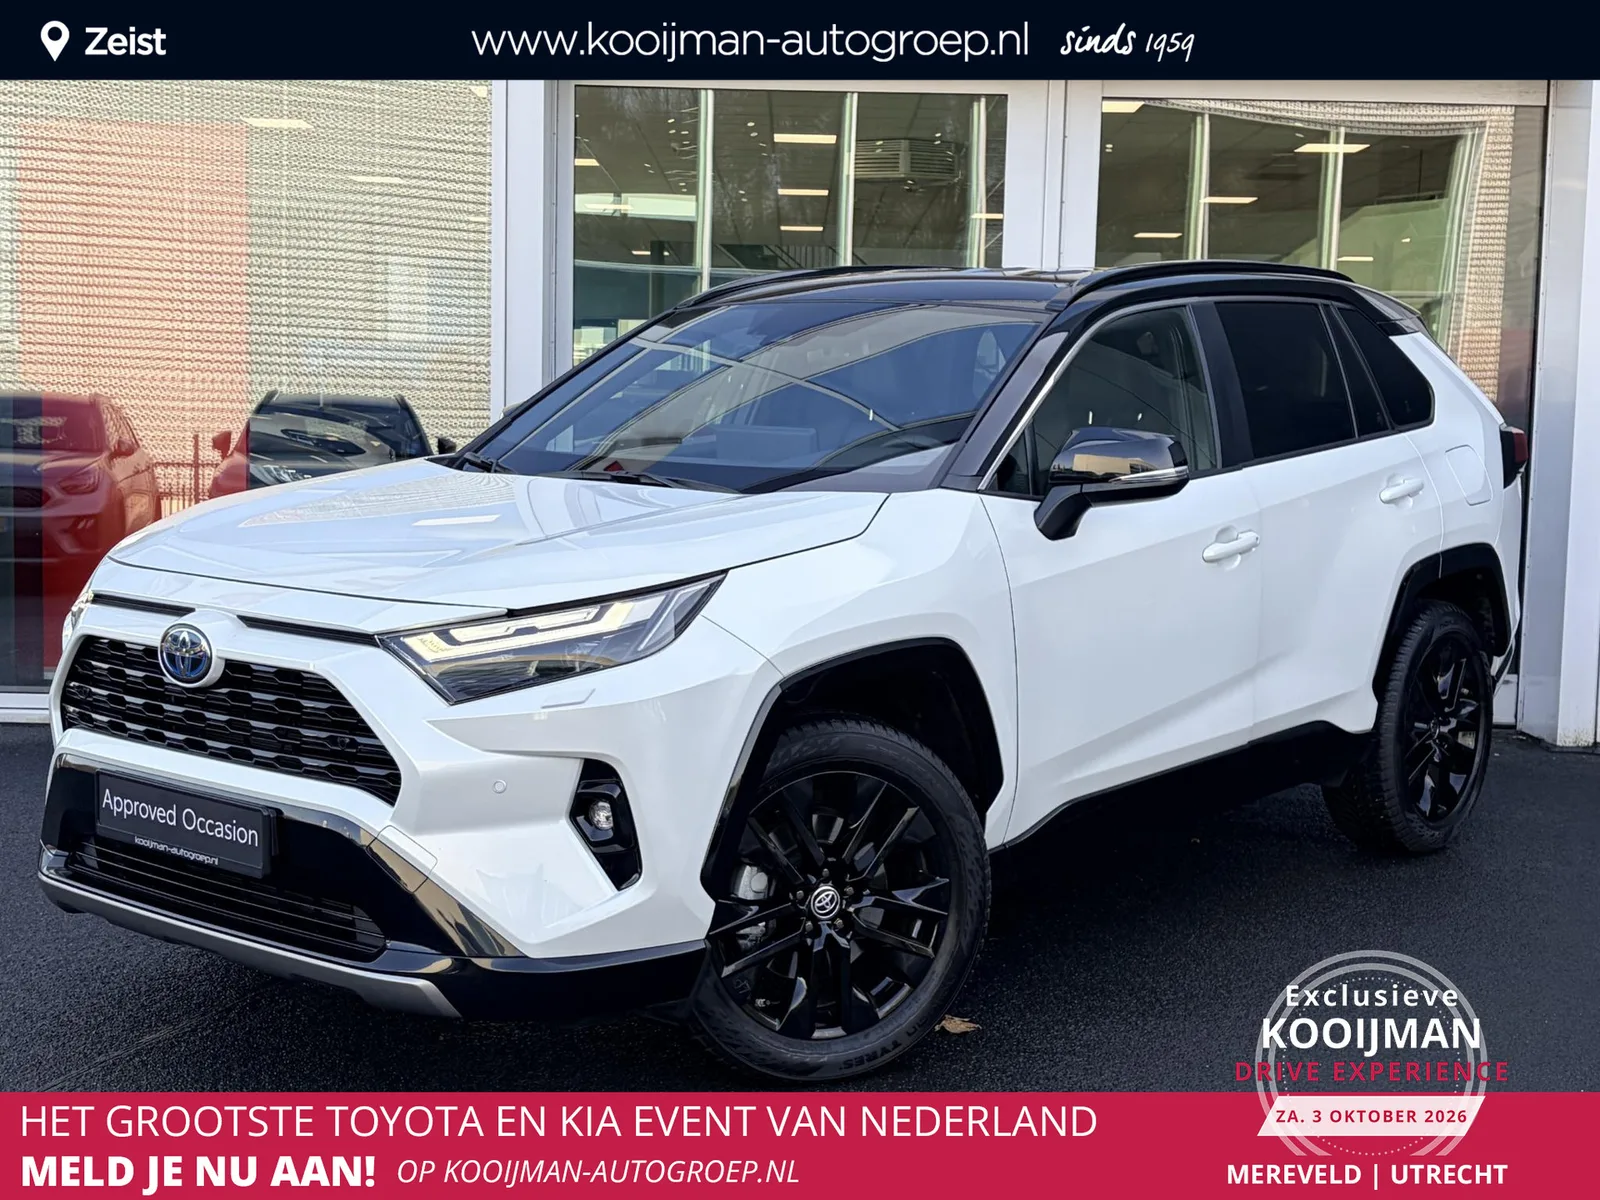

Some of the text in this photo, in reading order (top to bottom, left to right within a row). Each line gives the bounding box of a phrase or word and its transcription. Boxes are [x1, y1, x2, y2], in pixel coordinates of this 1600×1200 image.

[102, 788, 259, 846] Approved Occasion
[134, 836, 219, 865] kooijman-autogroep.nl
